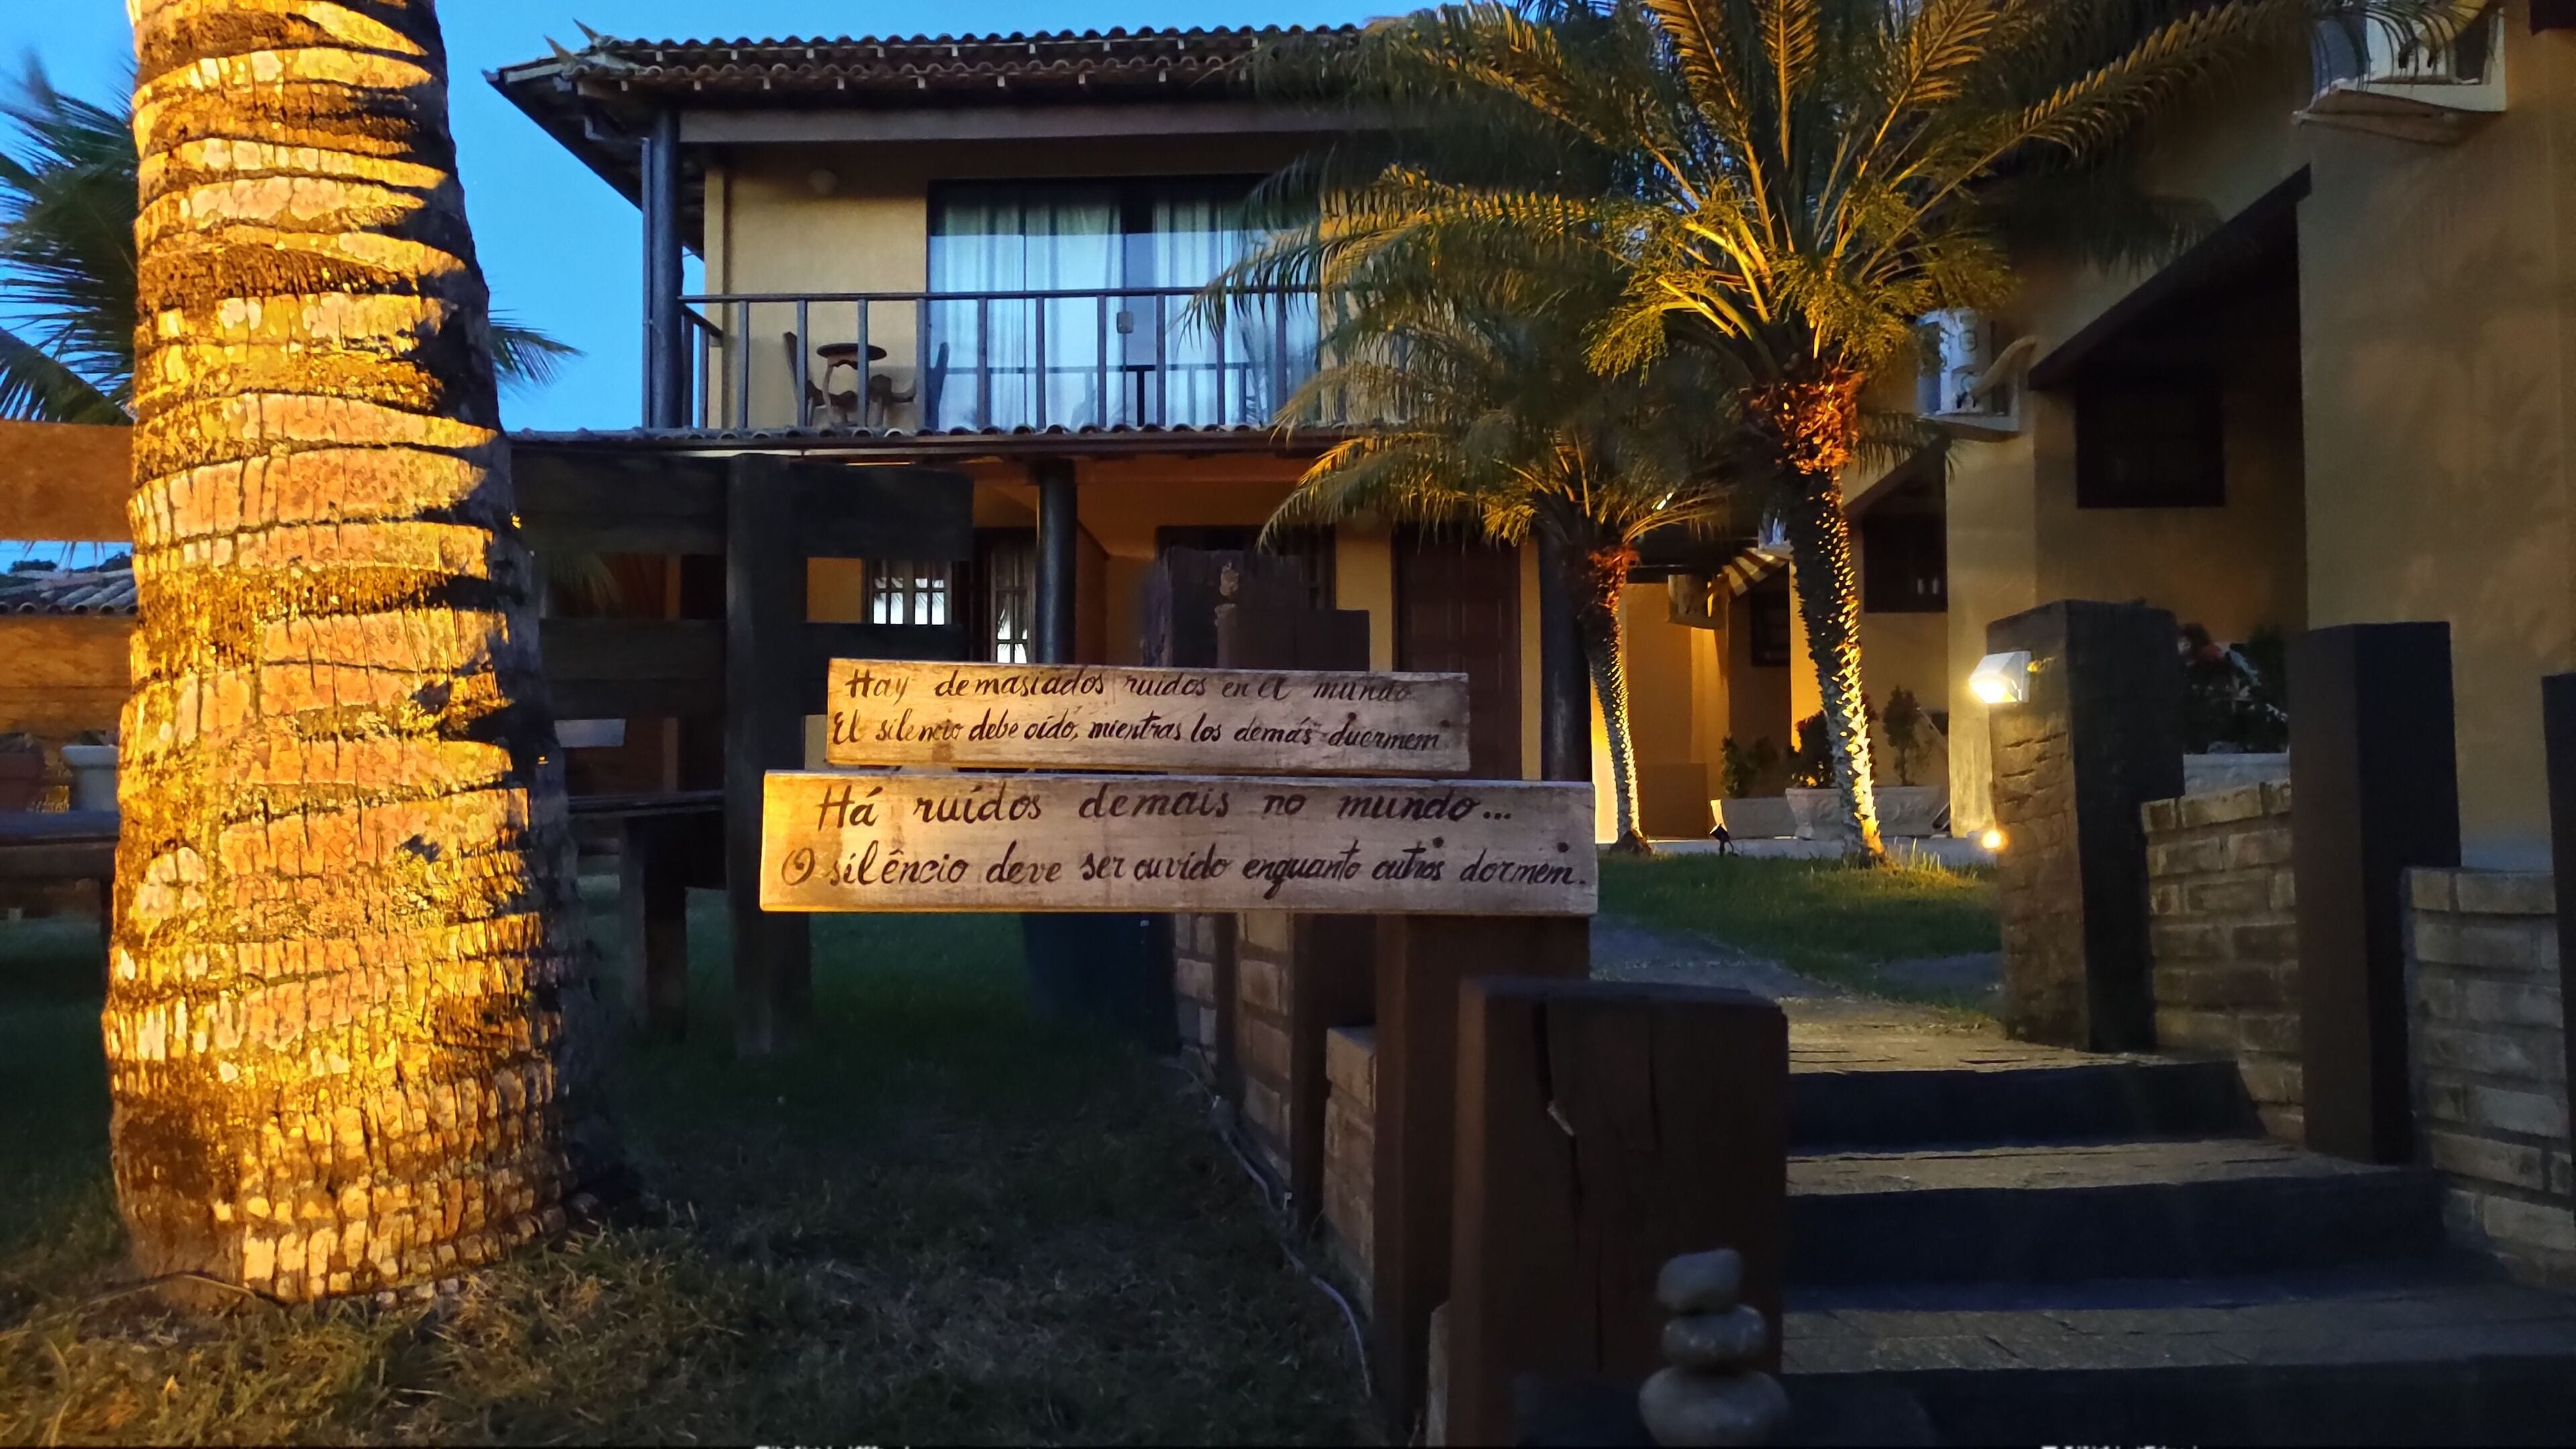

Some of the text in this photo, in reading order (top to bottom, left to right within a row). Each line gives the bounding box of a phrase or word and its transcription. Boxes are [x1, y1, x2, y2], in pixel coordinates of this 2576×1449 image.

[845, 669, 910, 705] Hay
[1124, 673, 1206, 696] ruidos
[1222, 682, 1250, 698] en
[1313, 680, 1411, 701] mundo
[833, 708, 865, 745] El
[875, 708, 963, 741] silencio
[968, 708, 1018, 741] debe
[1088, 710, 1181, 741] mientras
[1191, 713, 1222, 743] los
[1234, 716, 1313, 745] demás
[816, 784, 883, 831] Há
[1079, 783, 1229, 818] demais
[1263, 794, 1307, 816] no
[1337, 789, 1511, 822] mundo...
[782, 847, 816, 886] O
[985, 840, 1062, 884] deve
[1080, 853, 1126, 881] ser
